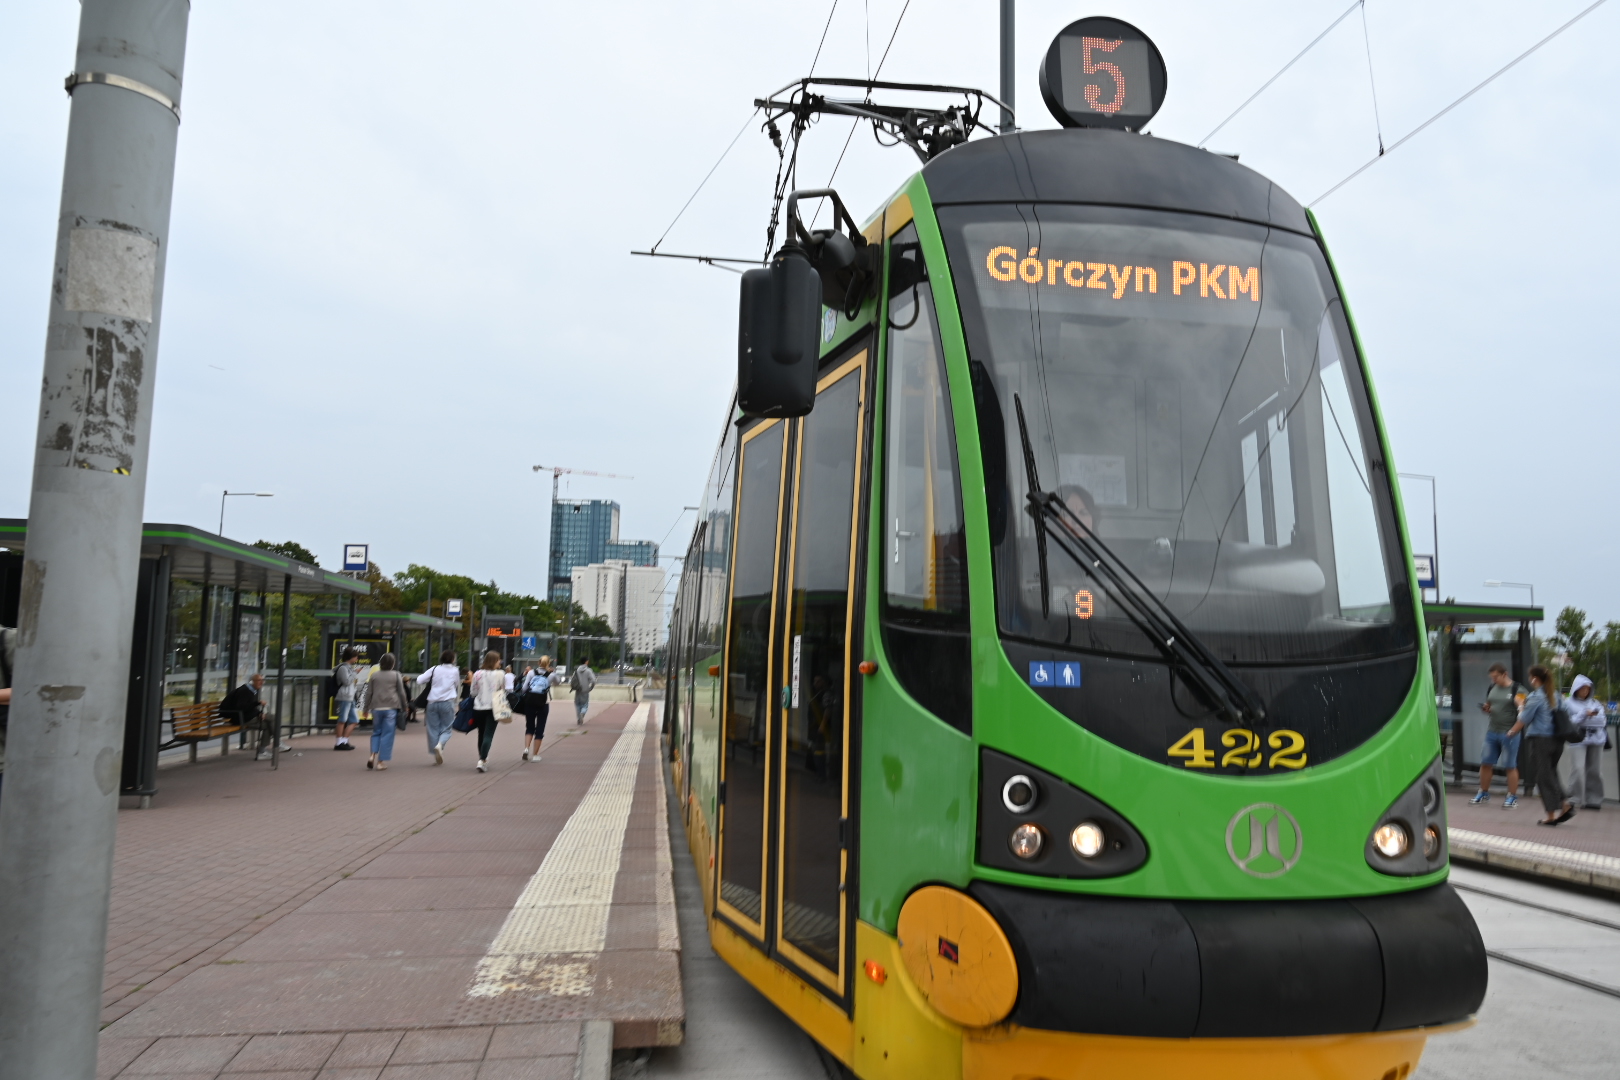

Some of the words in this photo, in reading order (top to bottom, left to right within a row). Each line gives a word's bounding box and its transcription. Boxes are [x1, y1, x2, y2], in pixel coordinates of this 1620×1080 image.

[1082, 36, 1126, 114] 5
[986, 245, 1158, 300] Górczyn
[1172, 260, 1260, 303] PKM
[1075, 589, 1093, 620] 9
[1167, 727, 1308, 770] 422
